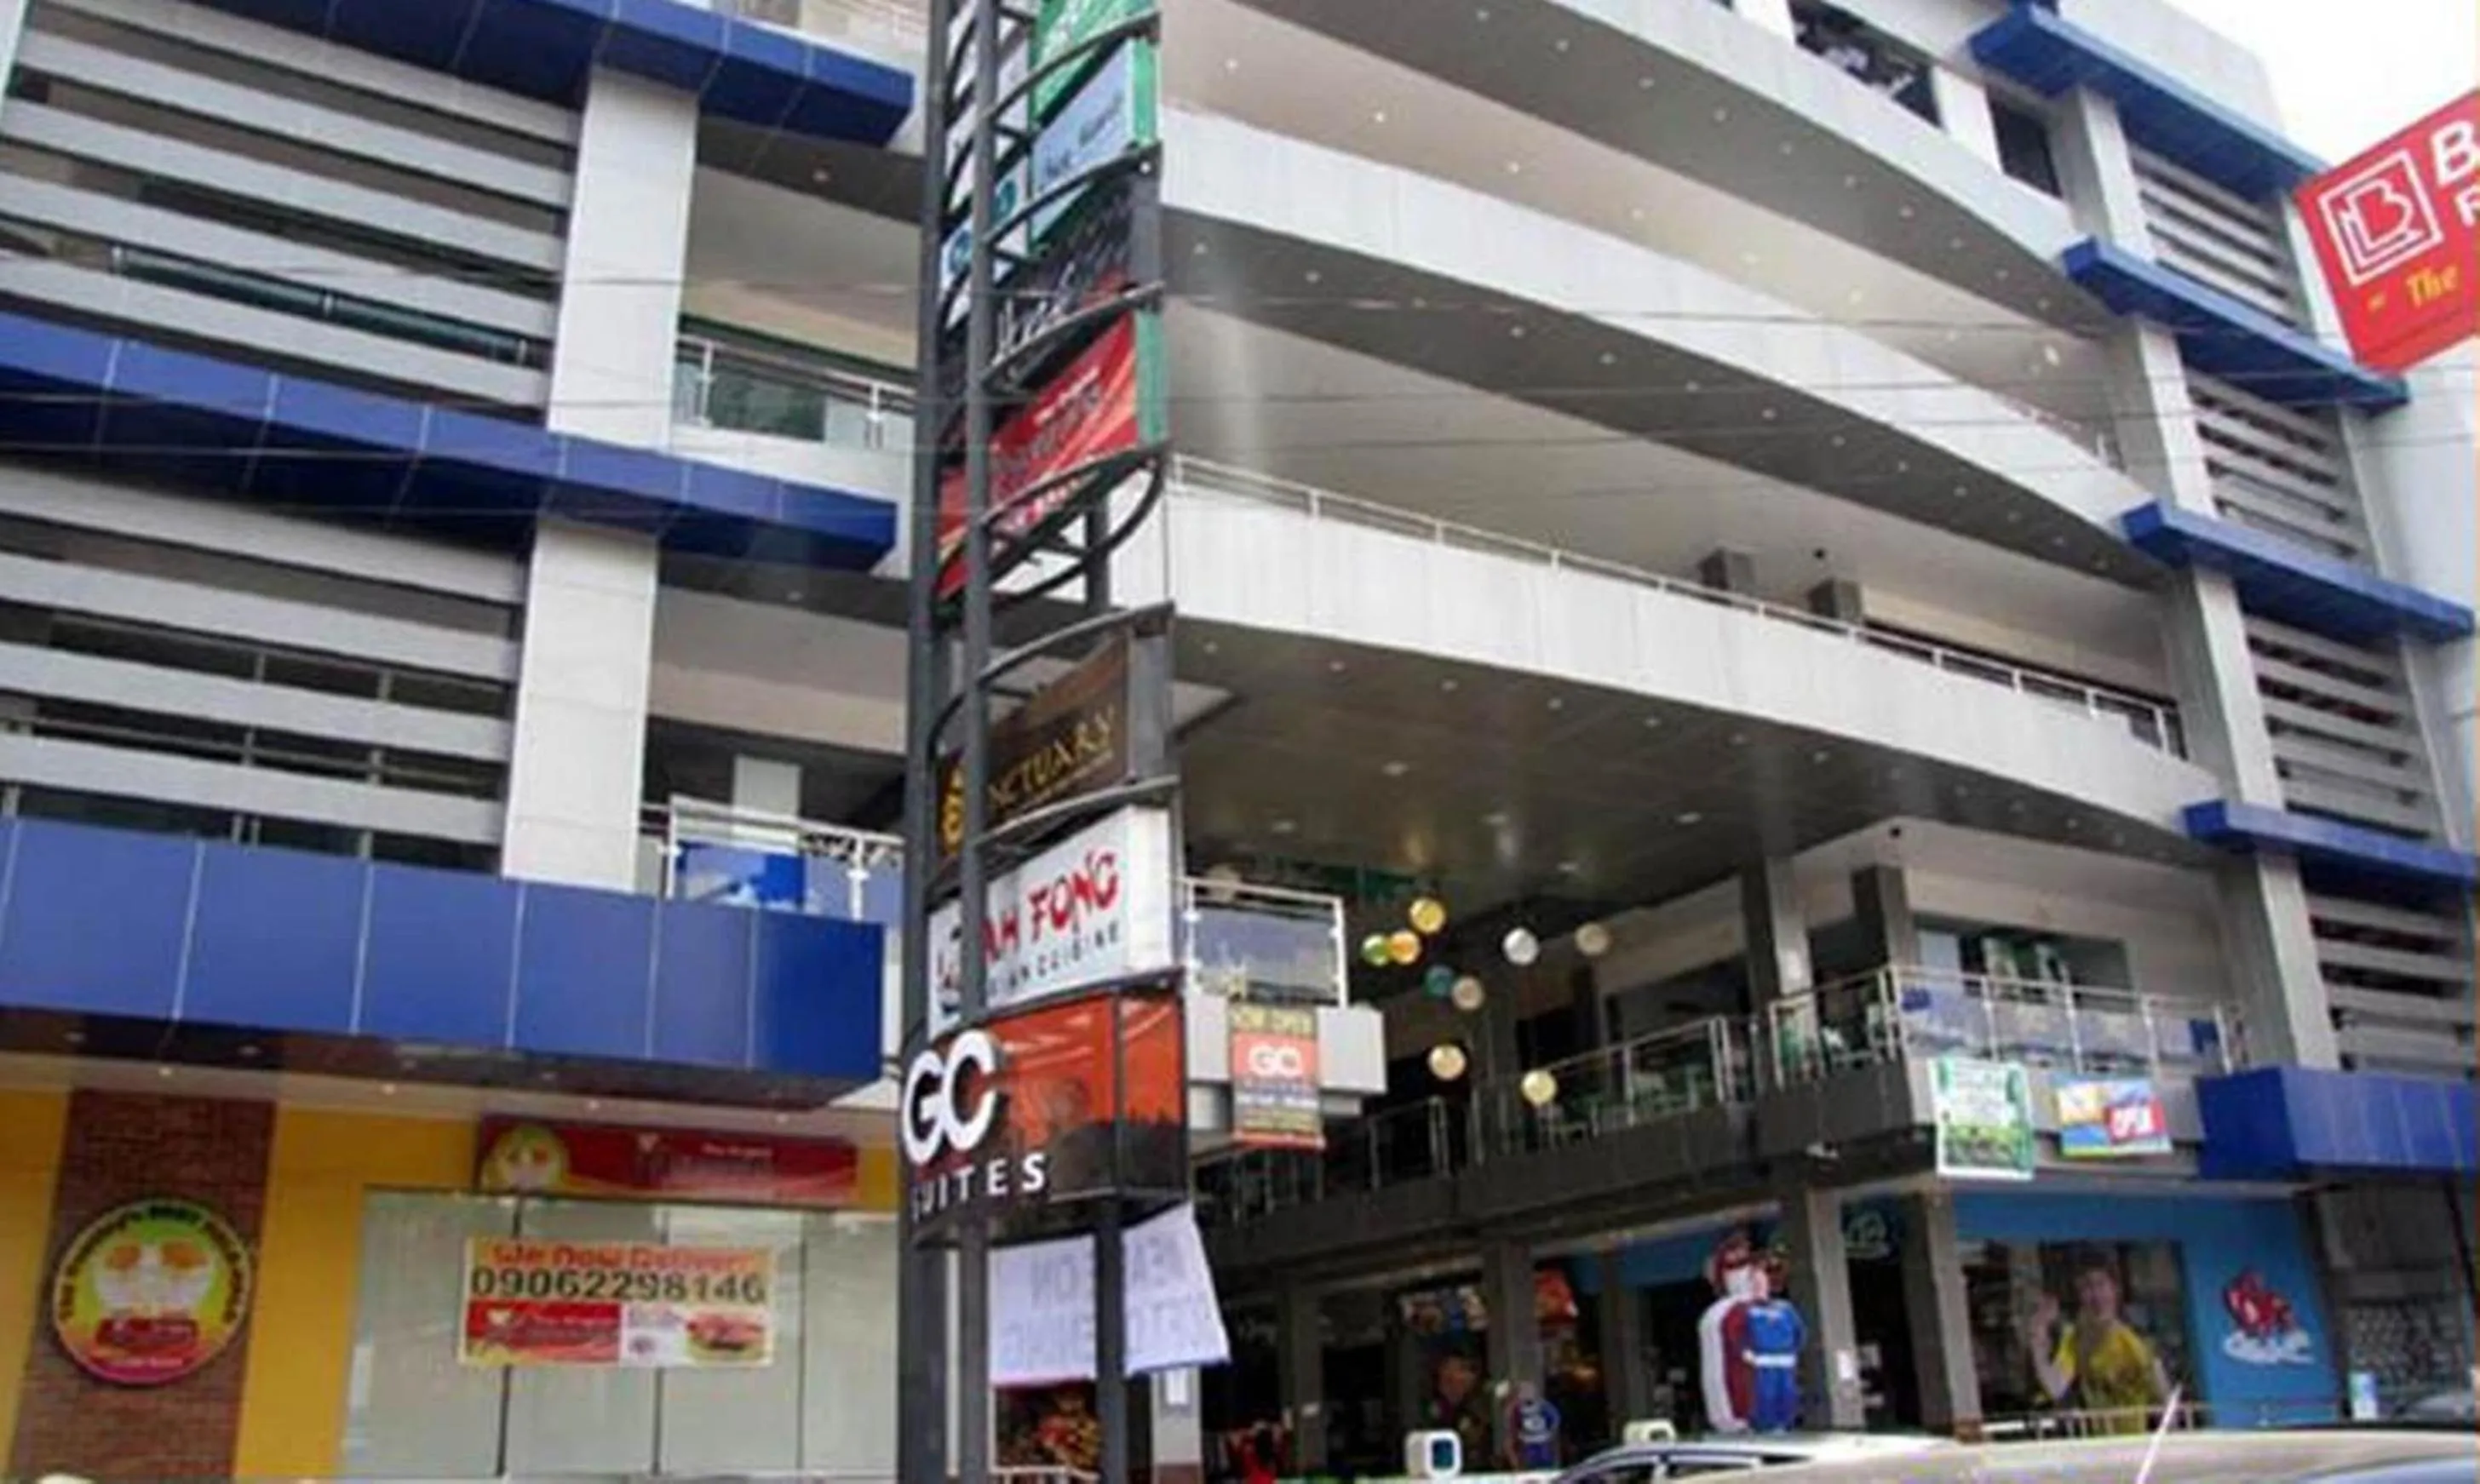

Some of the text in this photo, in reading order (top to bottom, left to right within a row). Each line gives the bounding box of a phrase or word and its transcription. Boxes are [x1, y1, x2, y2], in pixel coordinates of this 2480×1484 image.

[985, 705, 1117, 809] NCTUARY
[1027, 849, 1118, 943] FONG
[470, 1266, 766, 1305] 09062298146
